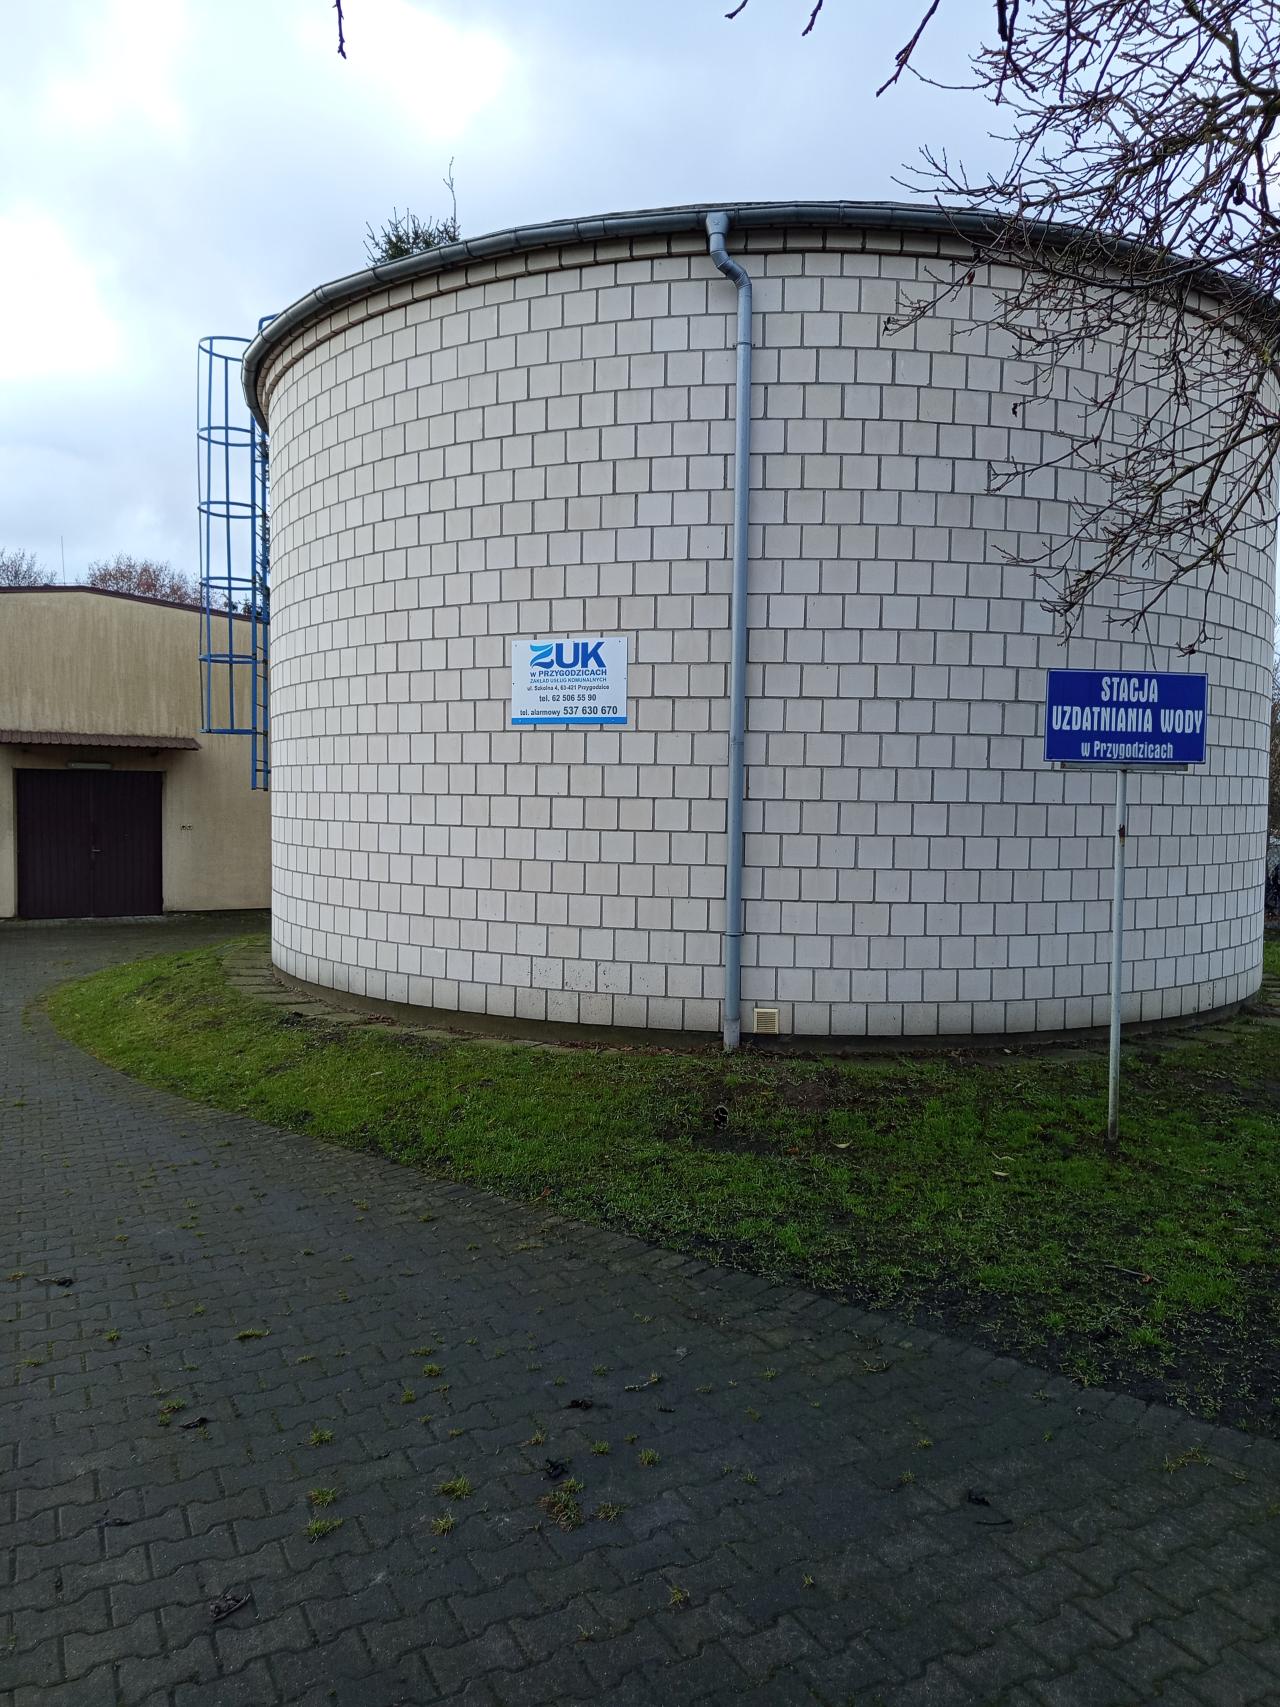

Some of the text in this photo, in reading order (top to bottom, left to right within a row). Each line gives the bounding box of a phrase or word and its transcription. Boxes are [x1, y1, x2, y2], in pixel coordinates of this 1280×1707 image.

[529, 641, 607, 669] ZUK
[538, 669, 607, 677] PRZYGODZICACH
[1101, 676, 1158, 702] STACJA
[564, 706, 579, 715] 537
[582, 706, 598, 715] 630
[601, 706, 618, 714] 670
[1052, 706, 1203, 733] UZDATNIANIA WODY
[1081, 741, 1174, 759] w Przygodzicach
